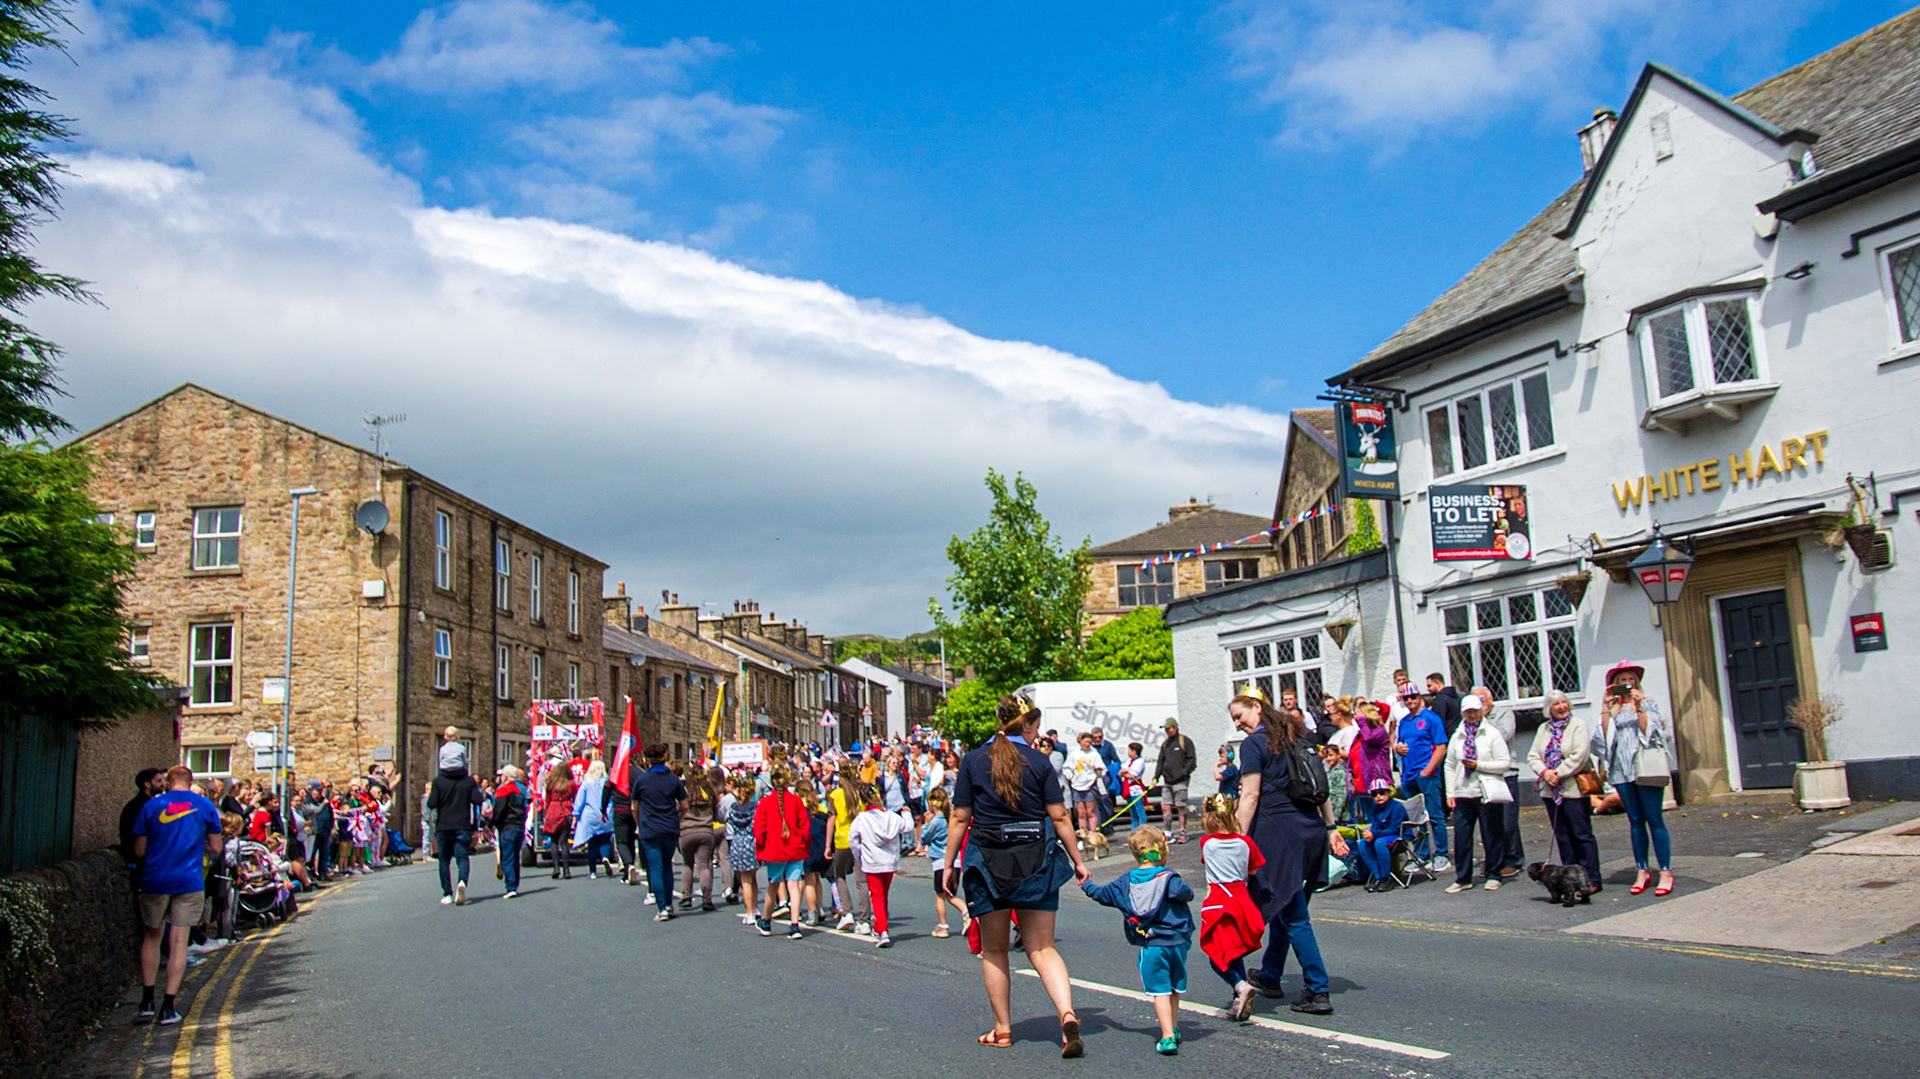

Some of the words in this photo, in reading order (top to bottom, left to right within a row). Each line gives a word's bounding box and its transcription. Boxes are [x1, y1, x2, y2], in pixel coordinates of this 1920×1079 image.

[1354, 480, 1375, 489] WHITE
[1376, 481, 1395, 490] HART
[1612, 458, 1722, 510] WHITE
[1728, 429, 1829, 484] HART
[1432, 507, 1460, 523] TO
[1466, 507, 1501, 522] LET
[1071, 700, 1167, 750] singleto
